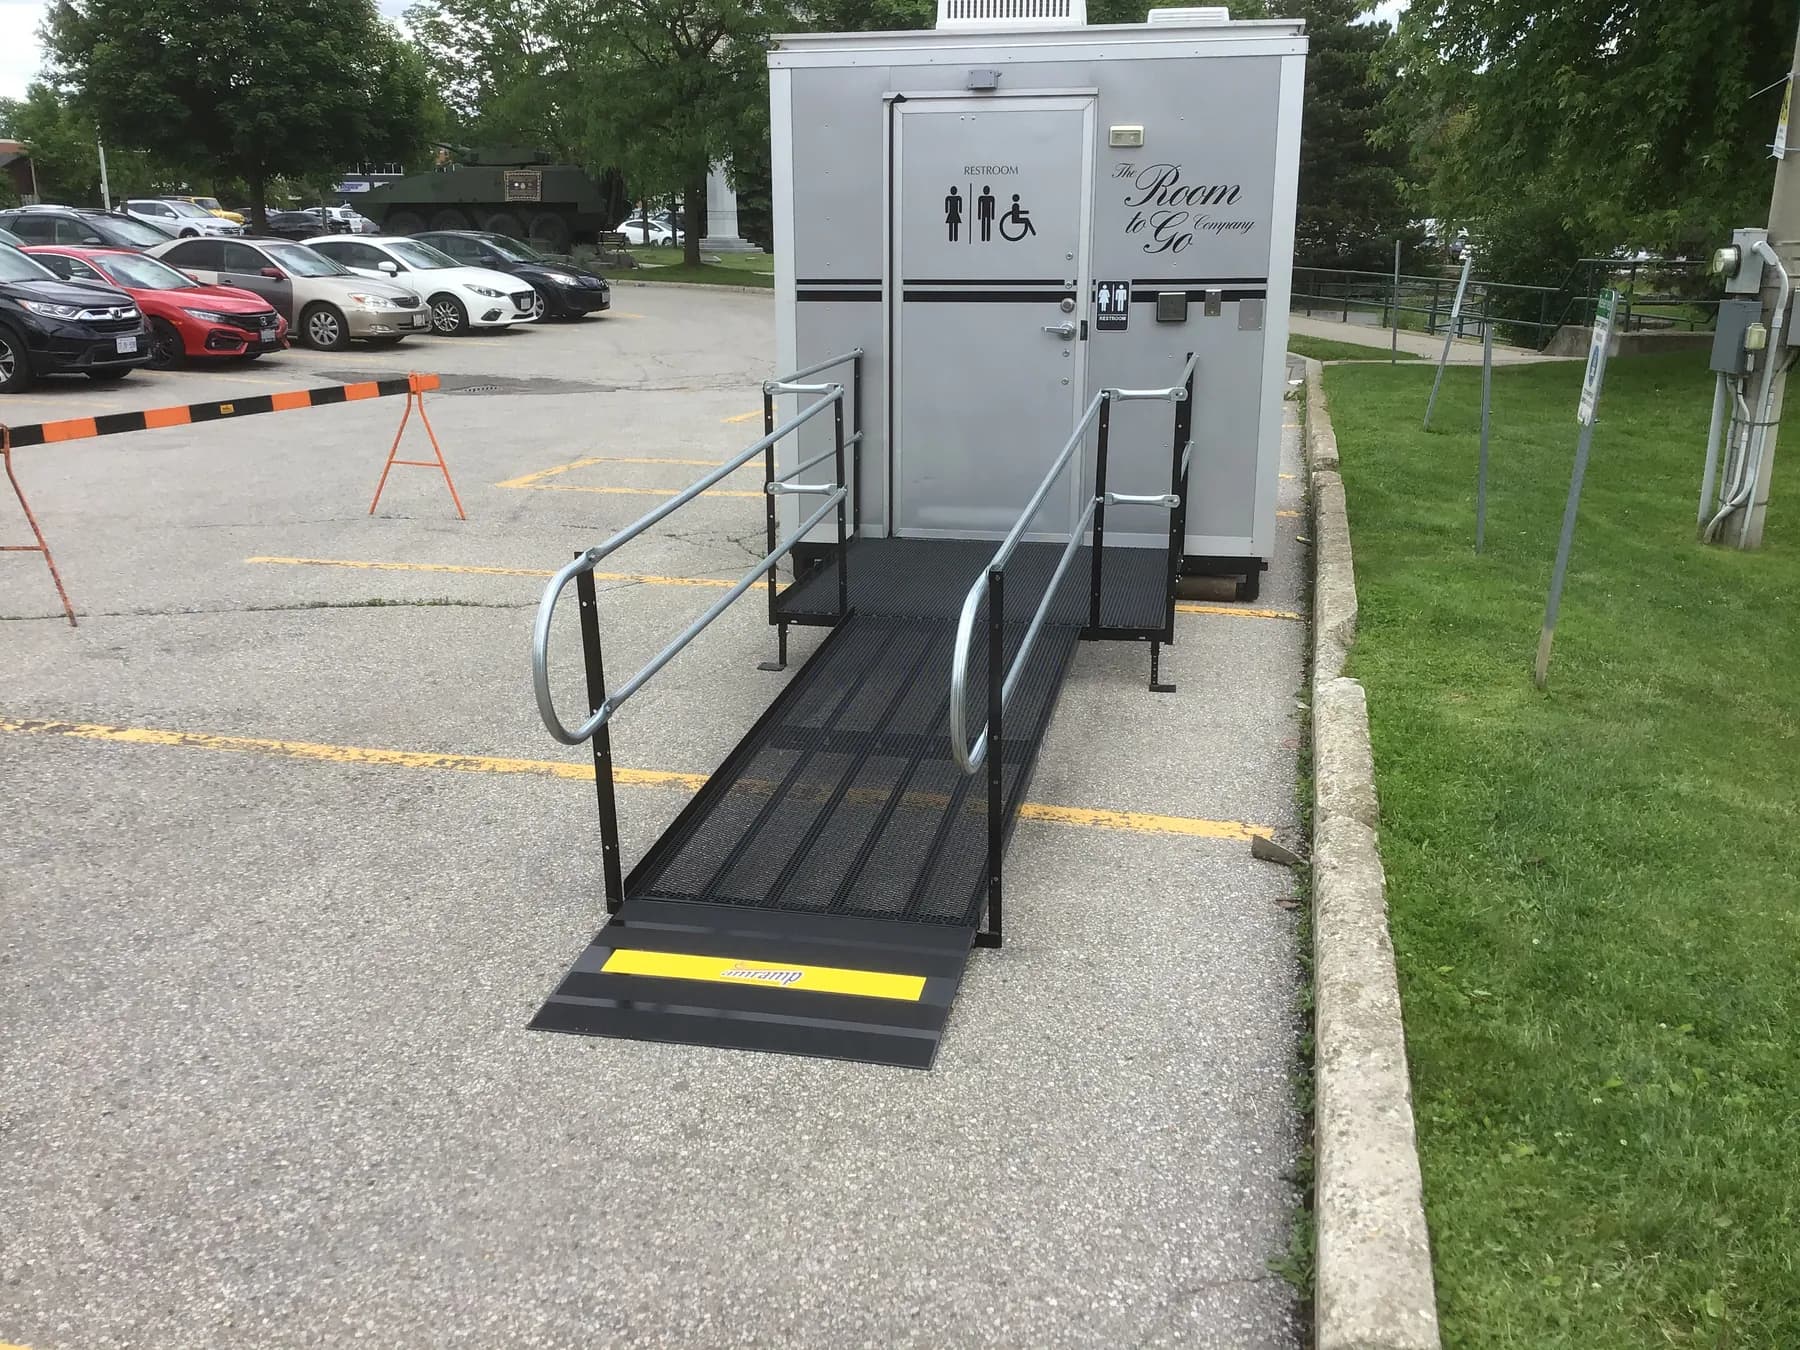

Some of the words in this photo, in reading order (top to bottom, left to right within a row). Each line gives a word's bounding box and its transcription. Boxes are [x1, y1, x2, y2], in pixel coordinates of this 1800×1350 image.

[963, 165, 1019, 176] RESTROOM
[1112, 162, 1137, 178] The
[1124, 163, 1242, 207] Room
[1125, 211, 1147, 233] to
[1143, 210, 1193, 253] Go
[1193, 214, 1255, 235] Company
